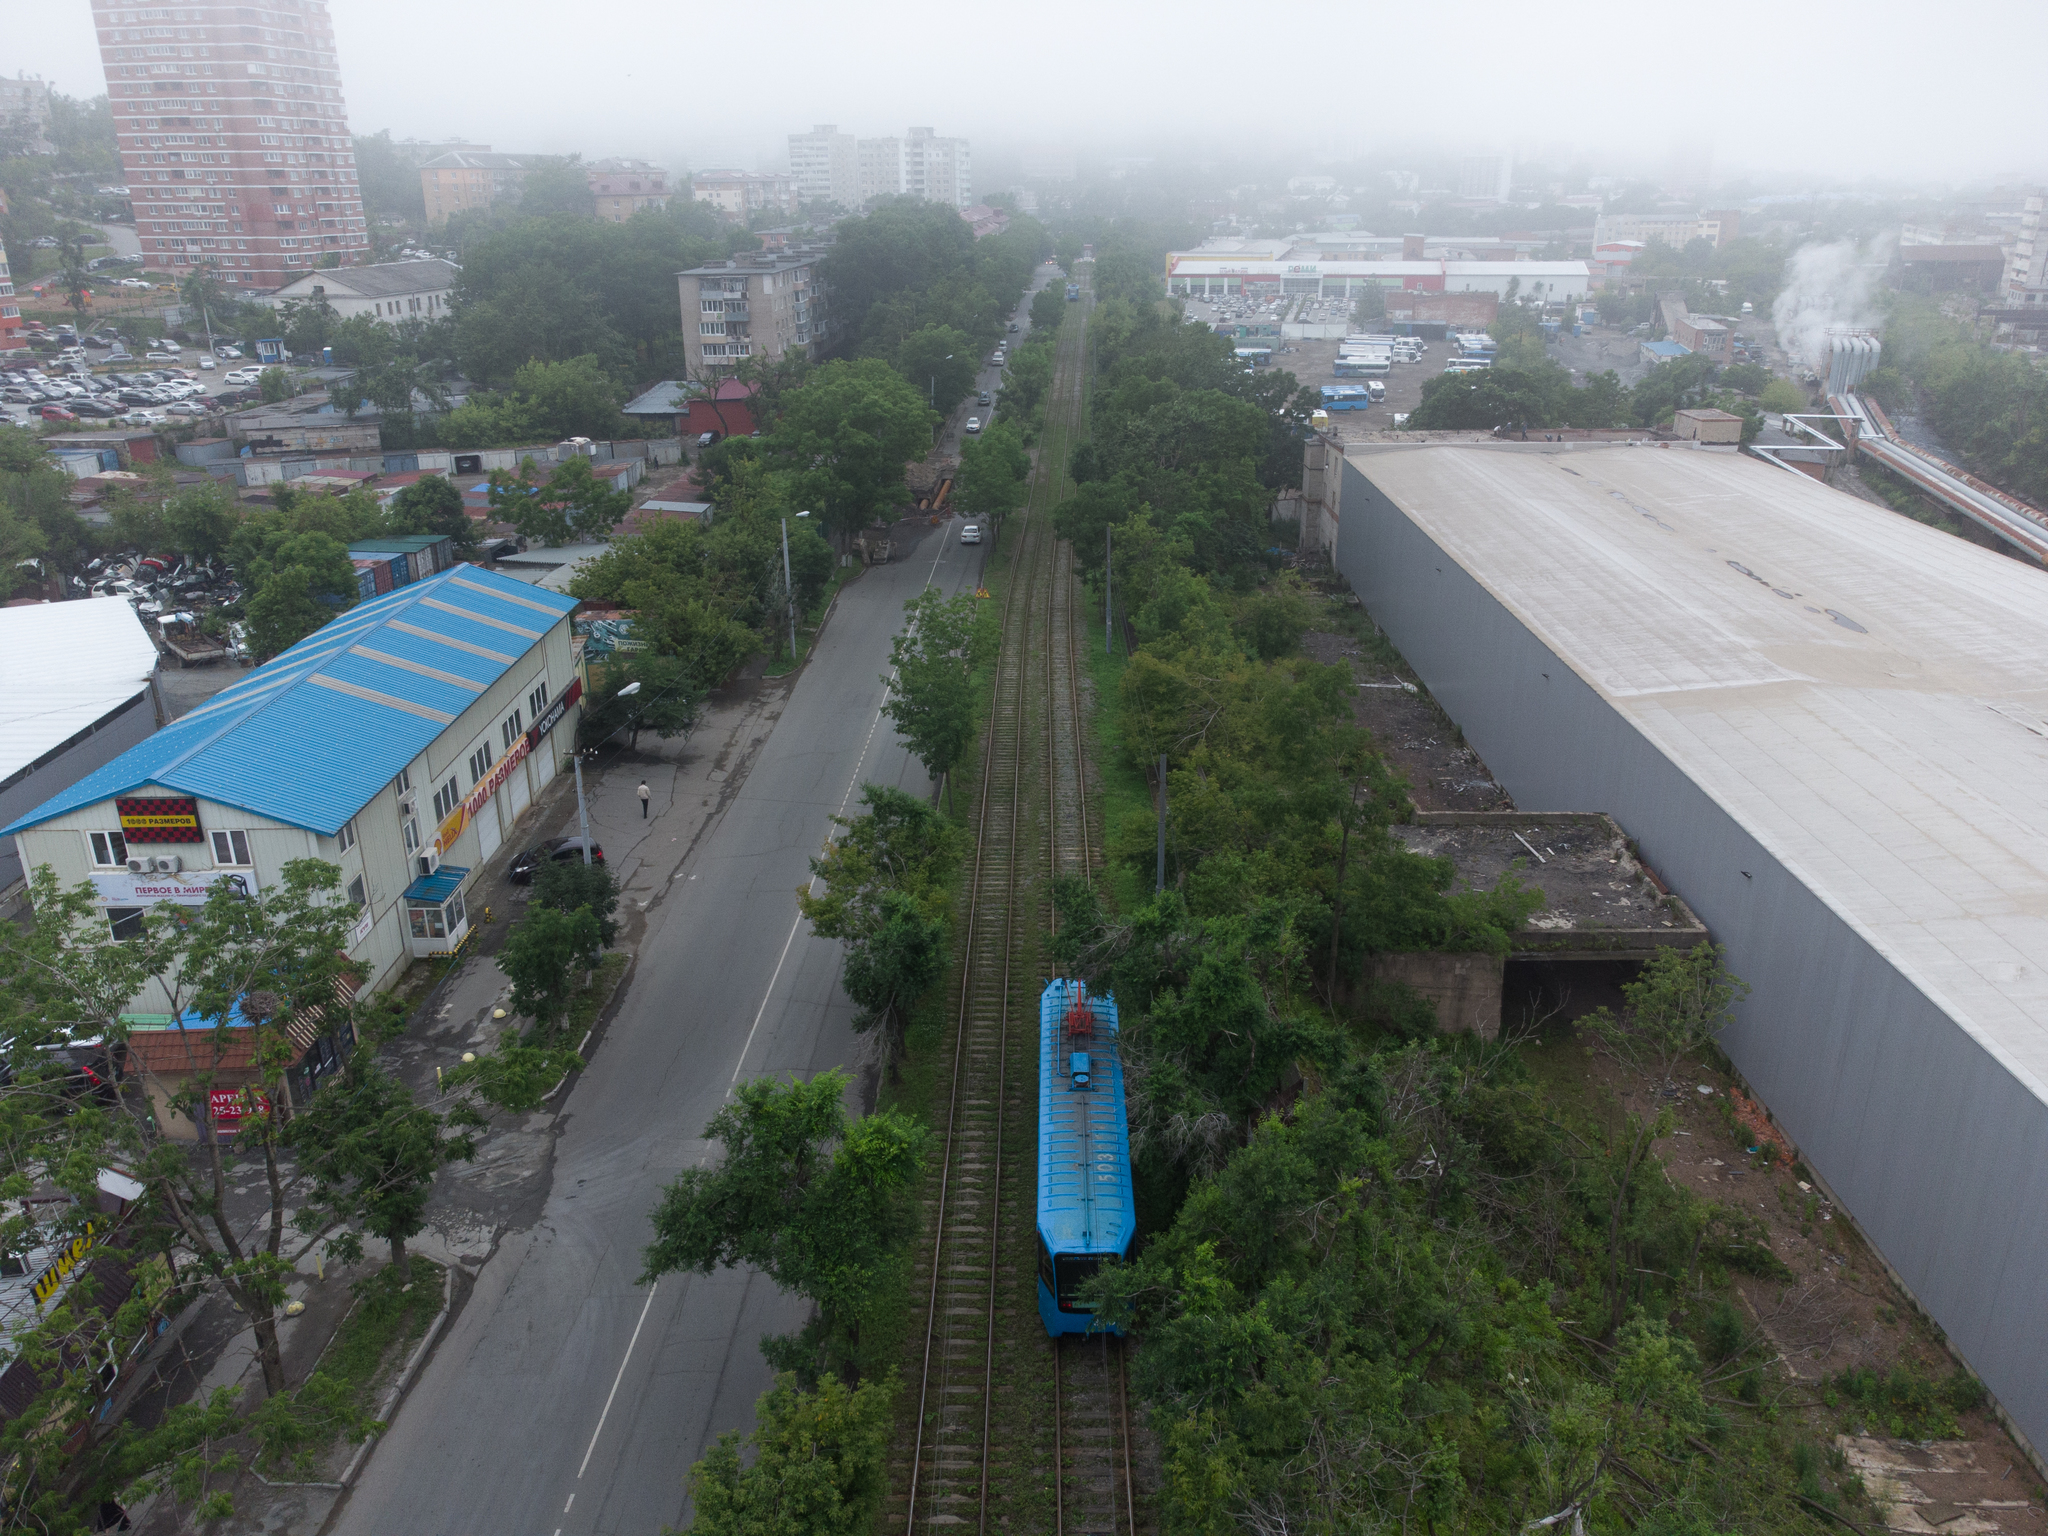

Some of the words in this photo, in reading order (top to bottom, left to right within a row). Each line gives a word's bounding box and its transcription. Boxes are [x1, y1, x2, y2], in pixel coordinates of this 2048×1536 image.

[538, 701, 565, 736] YOKOHAMA
[467, 787, 488, 818] 1000
[488, 737, 531, 797] РАЗМЕРОВ
[148, 817, 191, 825] РАЗМЕРОВ
